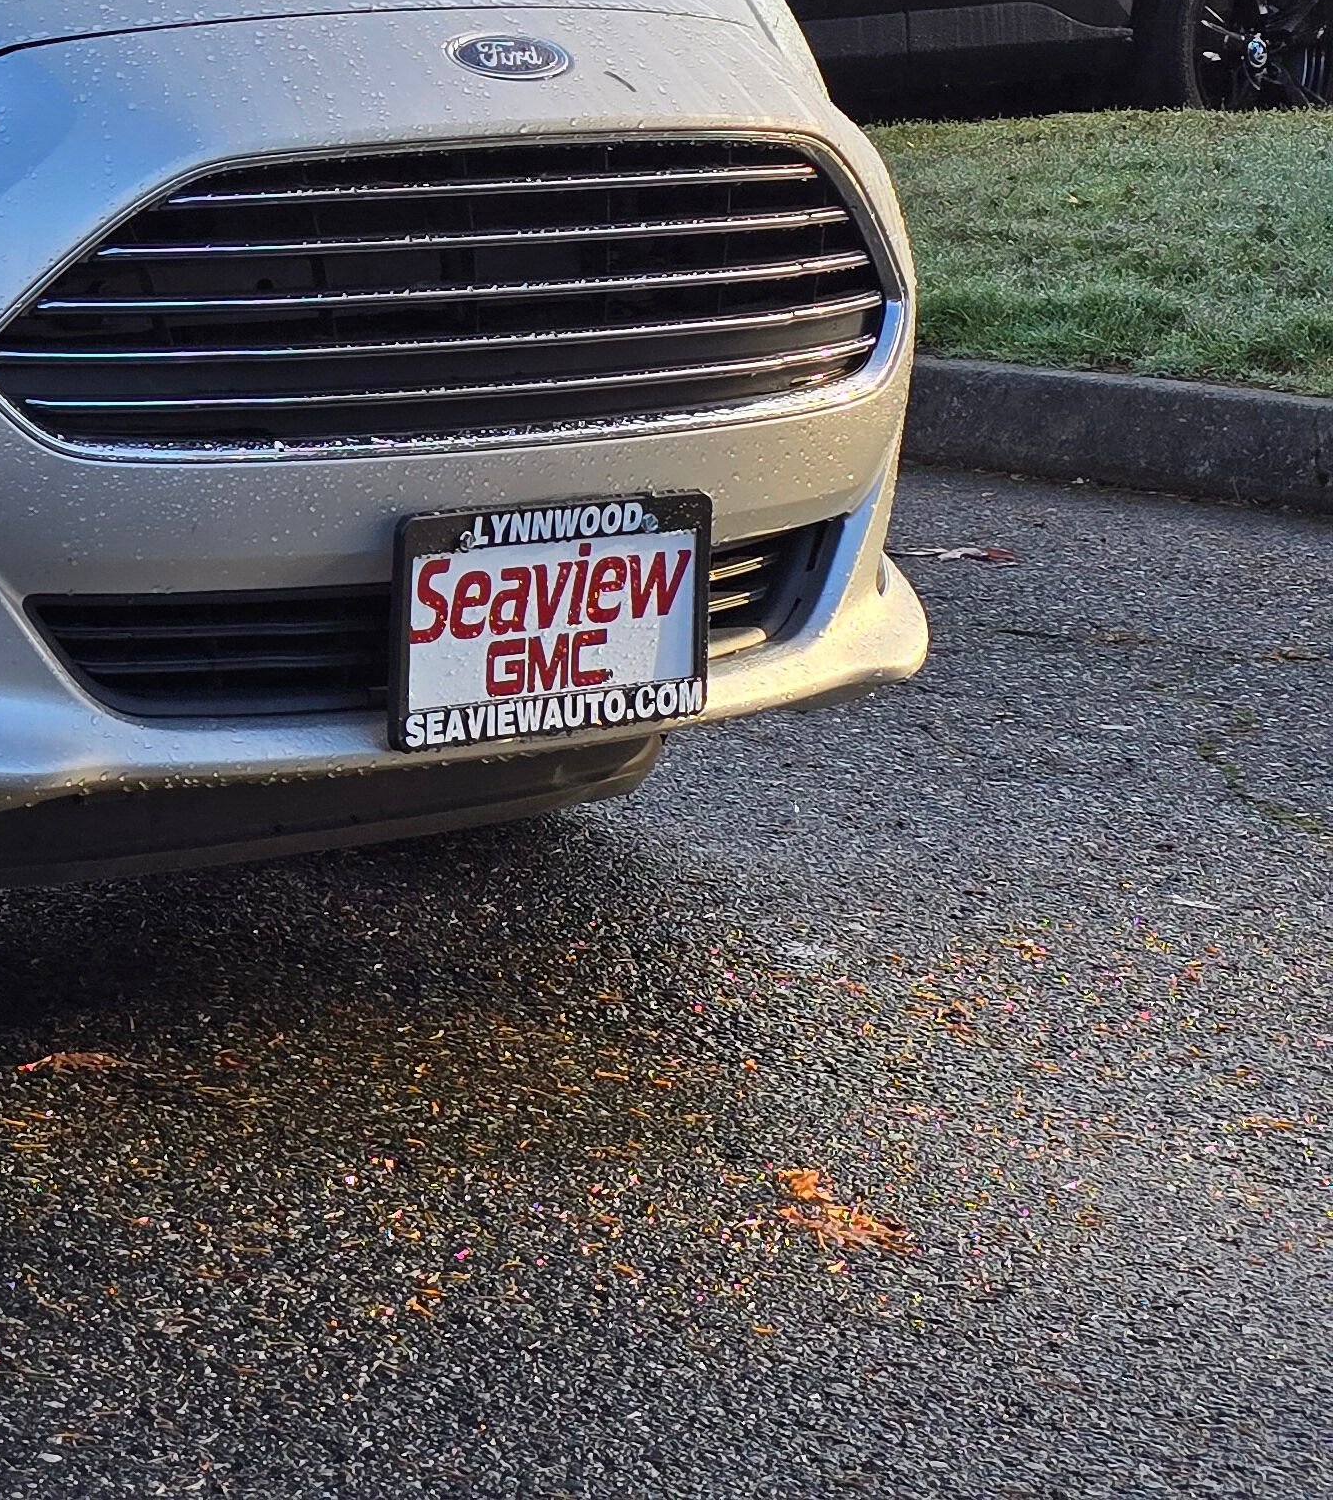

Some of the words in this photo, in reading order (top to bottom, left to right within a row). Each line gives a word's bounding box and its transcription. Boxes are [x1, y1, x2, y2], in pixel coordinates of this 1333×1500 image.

[476, 41, 542, 67] Ford
[474, 502, 643, 547] LYNNWOOD
[409, 542, 692, 645] Seaview
[485, 628, 613, 697] GMC
[405, 677, 703, 748] SEAVIEWAUTO.COM
